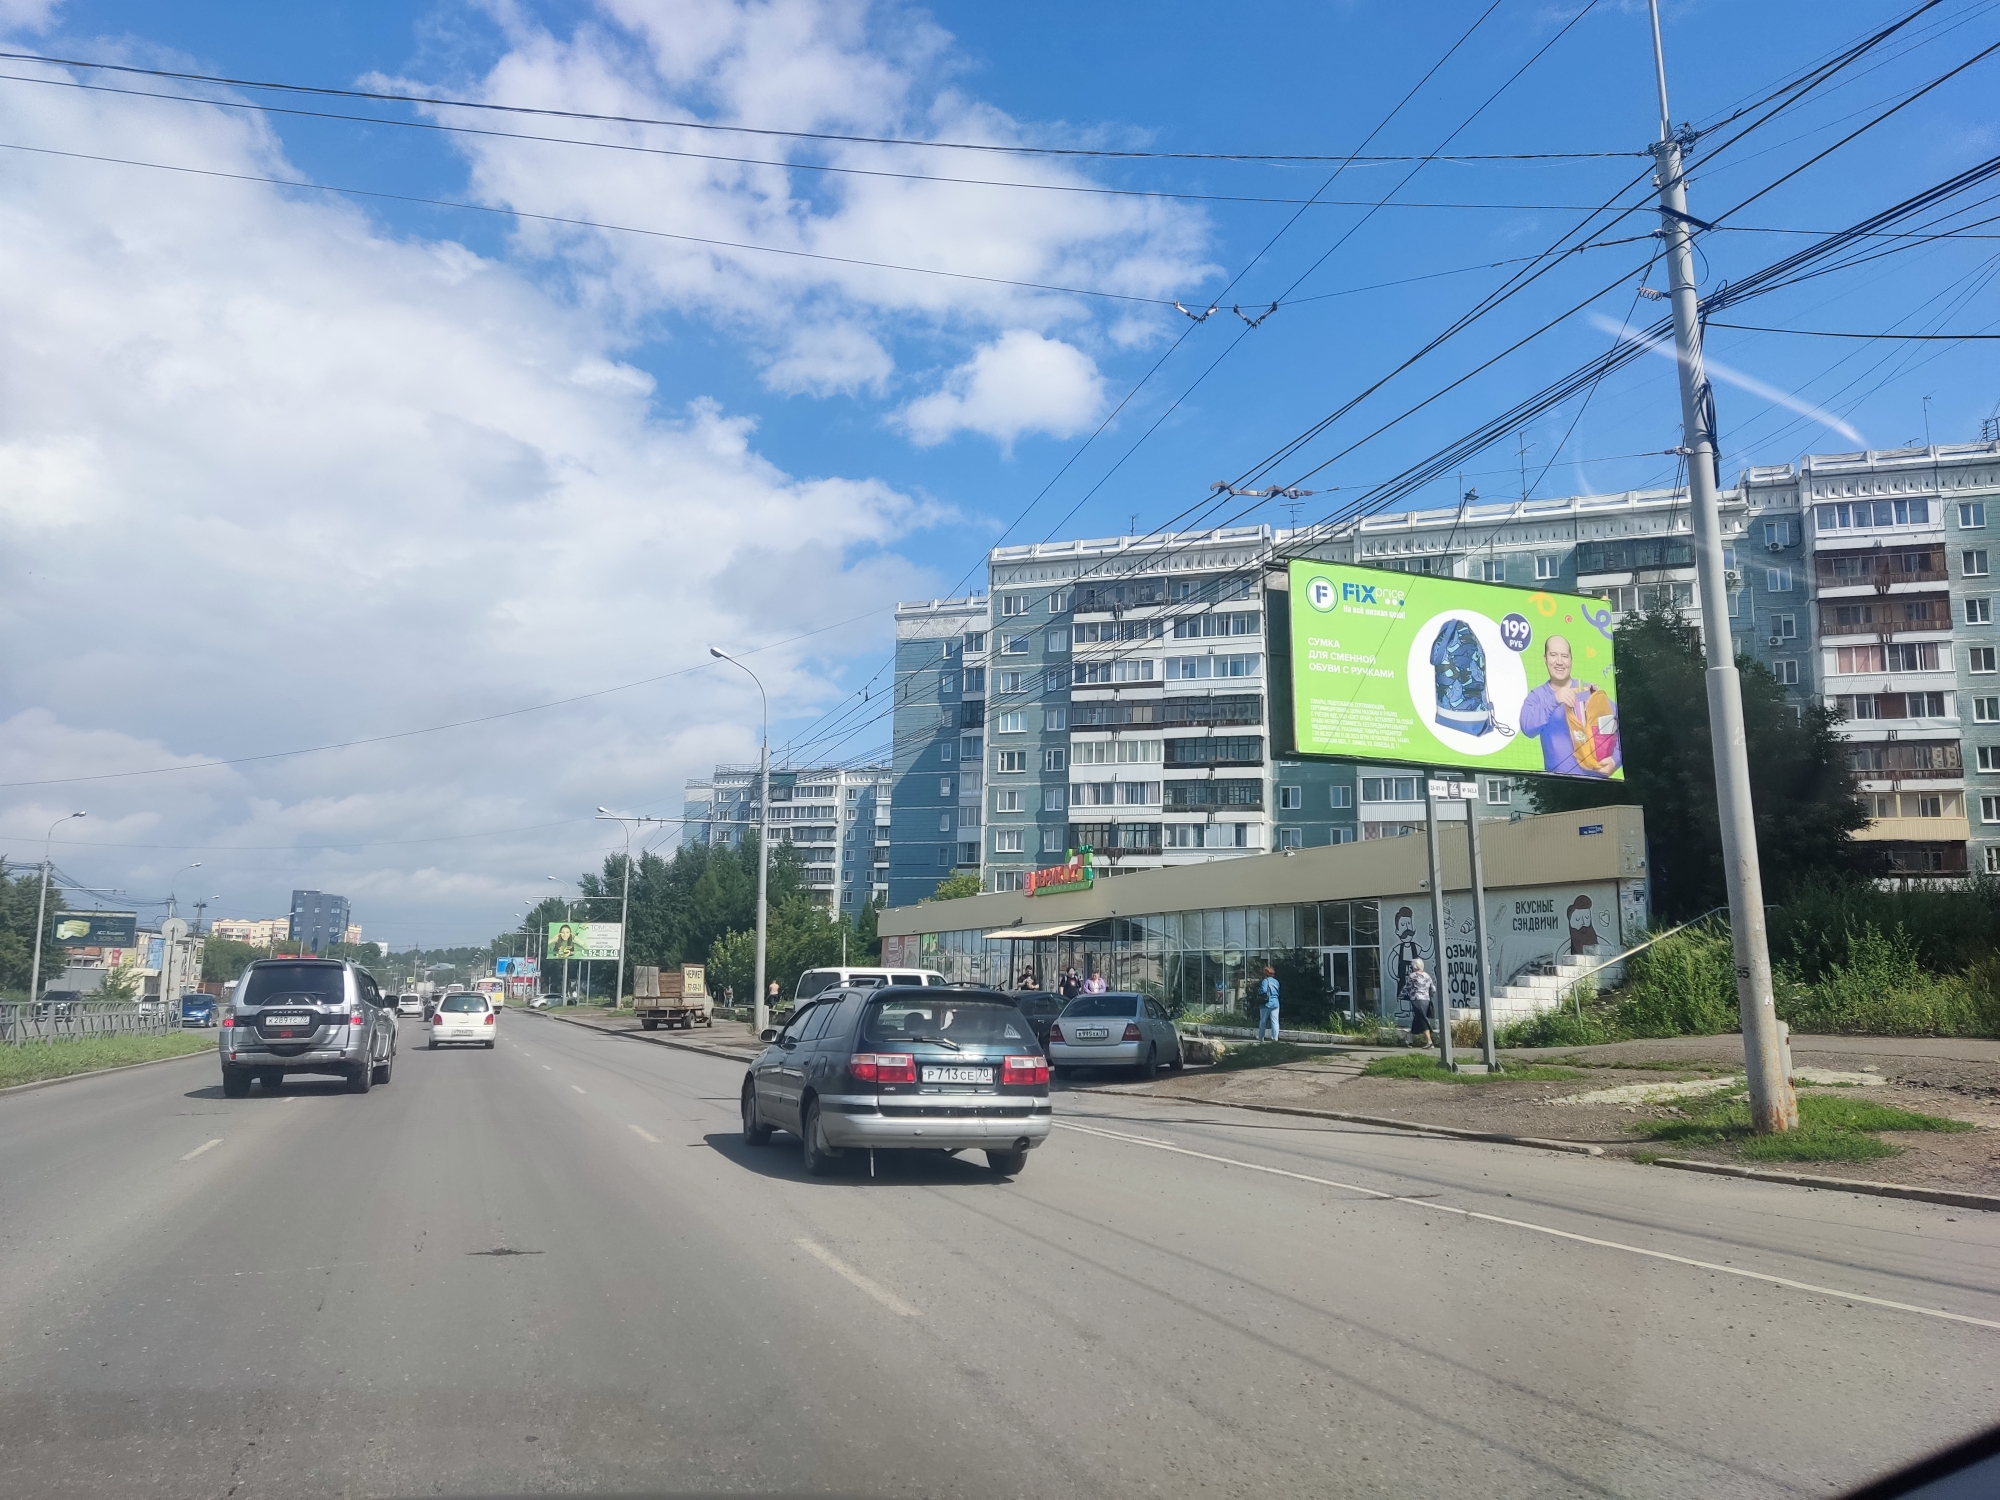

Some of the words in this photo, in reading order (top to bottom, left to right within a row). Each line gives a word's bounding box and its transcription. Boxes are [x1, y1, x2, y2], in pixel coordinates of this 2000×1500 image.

[1316, 585, 1328, 603] F
[1343, 604, 1352, 613] На
[1353, 606, 1364, 614] всё
[1365, 609, 1388, 617] низкая
[1503, 619, 1529, 639] 199
[1307, 637, 1341, 649] СУМКА
[1509, 639, 1523, 648] РУБ
[1308, 649, 1328, 660] ДЛЯ
[1330, 651, 1376, 665] СМЕННОЙ
[1309, 662, 1340, 674] ОБУВИ
[1342, 665, 1349, 675] С
[1351, 666, 1395, 679] РУЧКАМИ
[1515, 899, 1554, 915] ВКУСНЫЕ
[1512, 916, 1558, 932] СЭНДВИЧИ
[588, 949, 619, 957] 52-08-40
